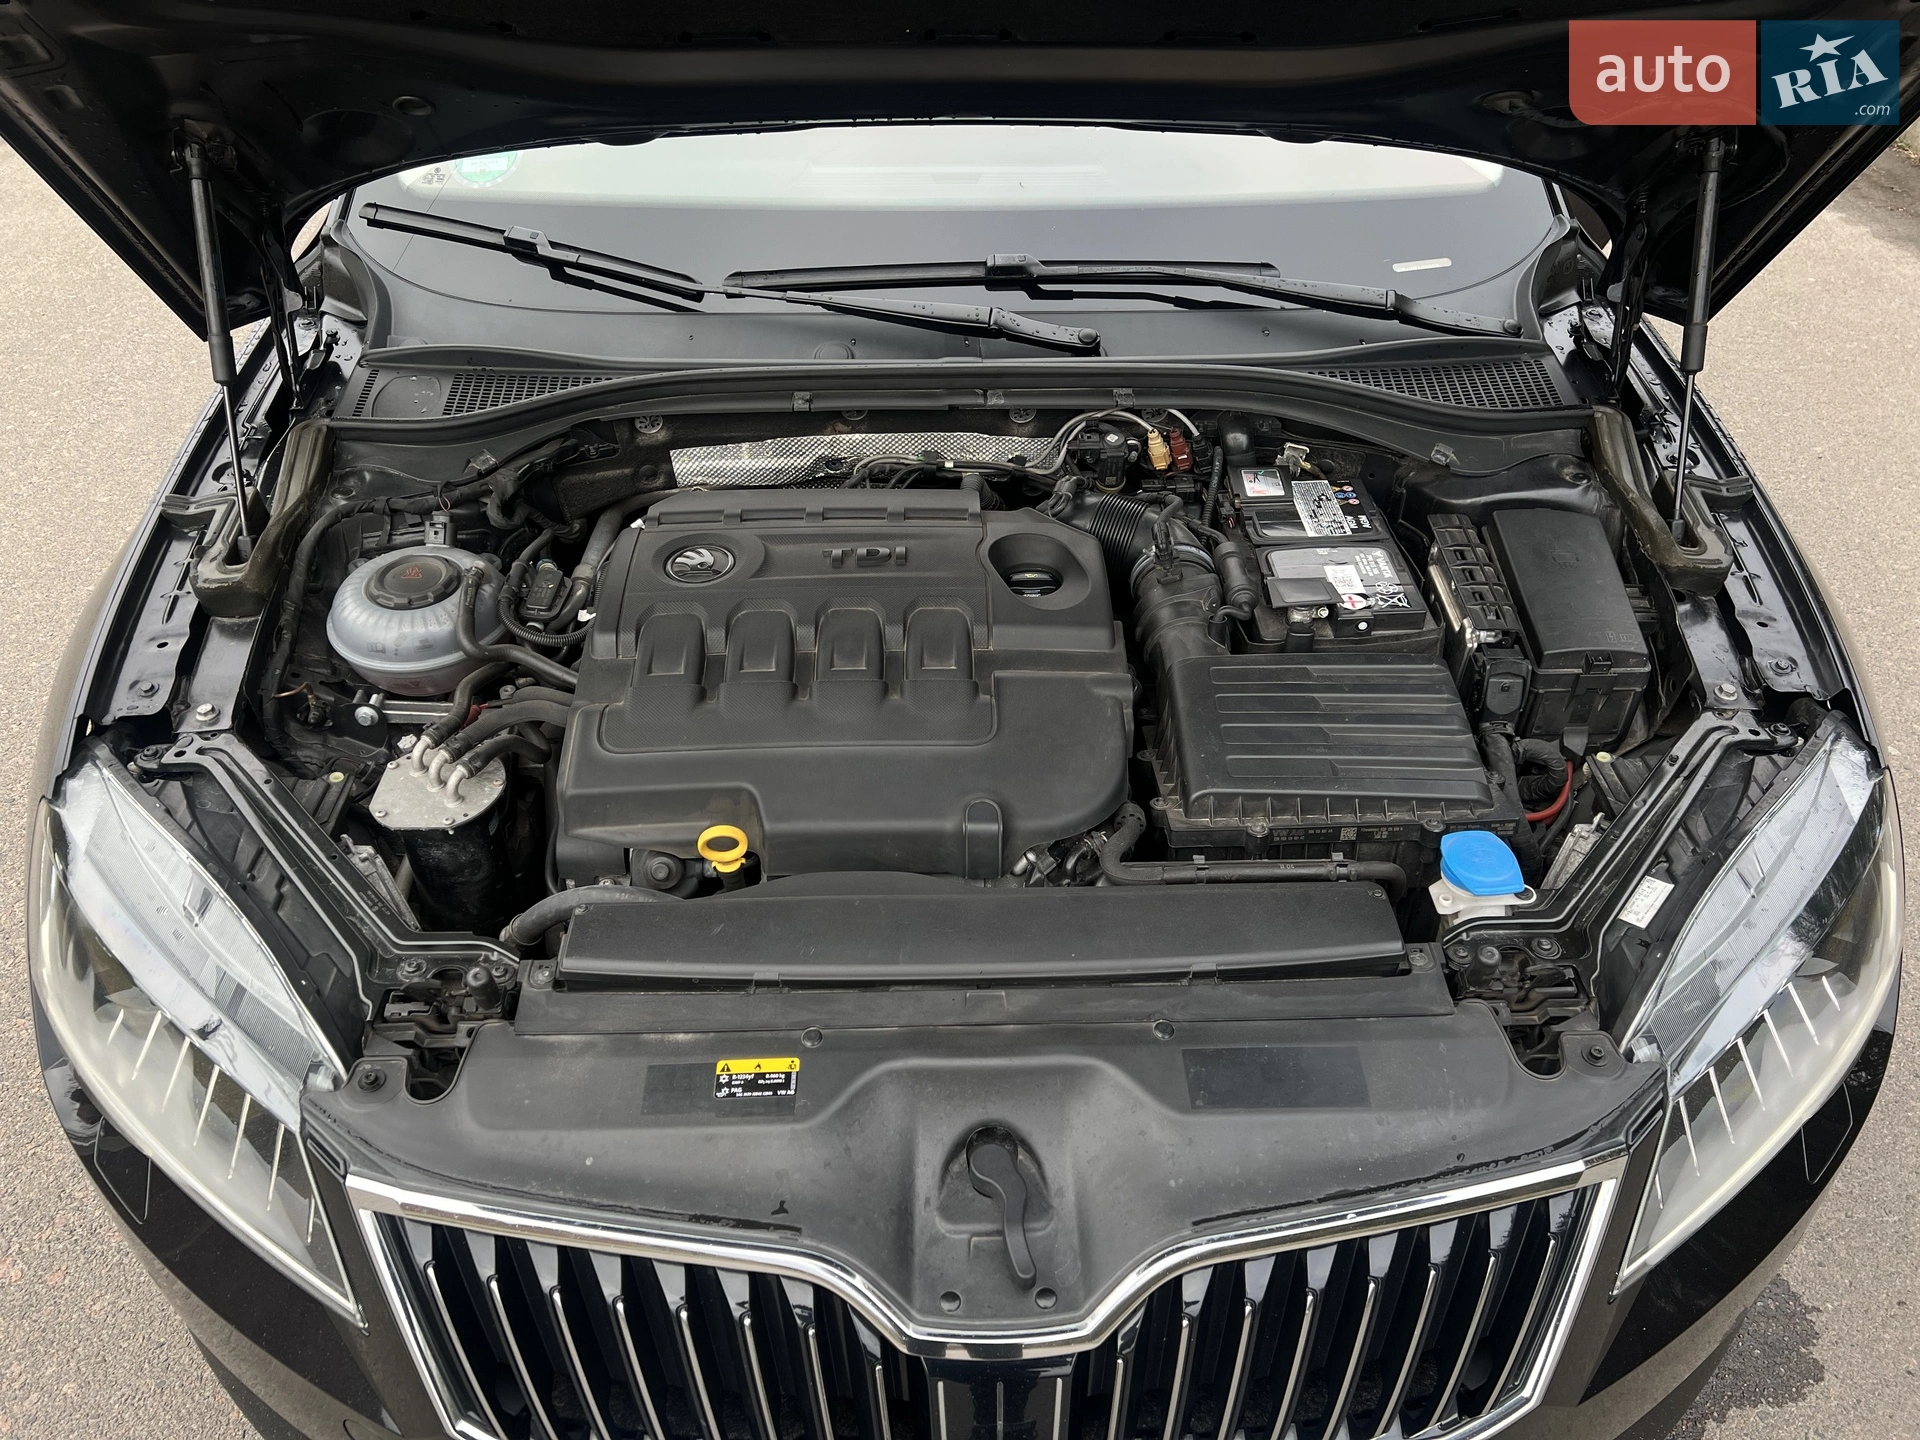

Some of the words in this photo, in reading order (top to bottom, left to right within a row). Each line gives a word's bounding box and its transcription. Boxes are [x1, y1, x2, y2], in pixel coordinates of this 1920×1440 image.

[1345, 515, 1359, 529] AGM
[822, 546, 907, 568] TDI
[1376, 557, 1393, 578] VARTA
